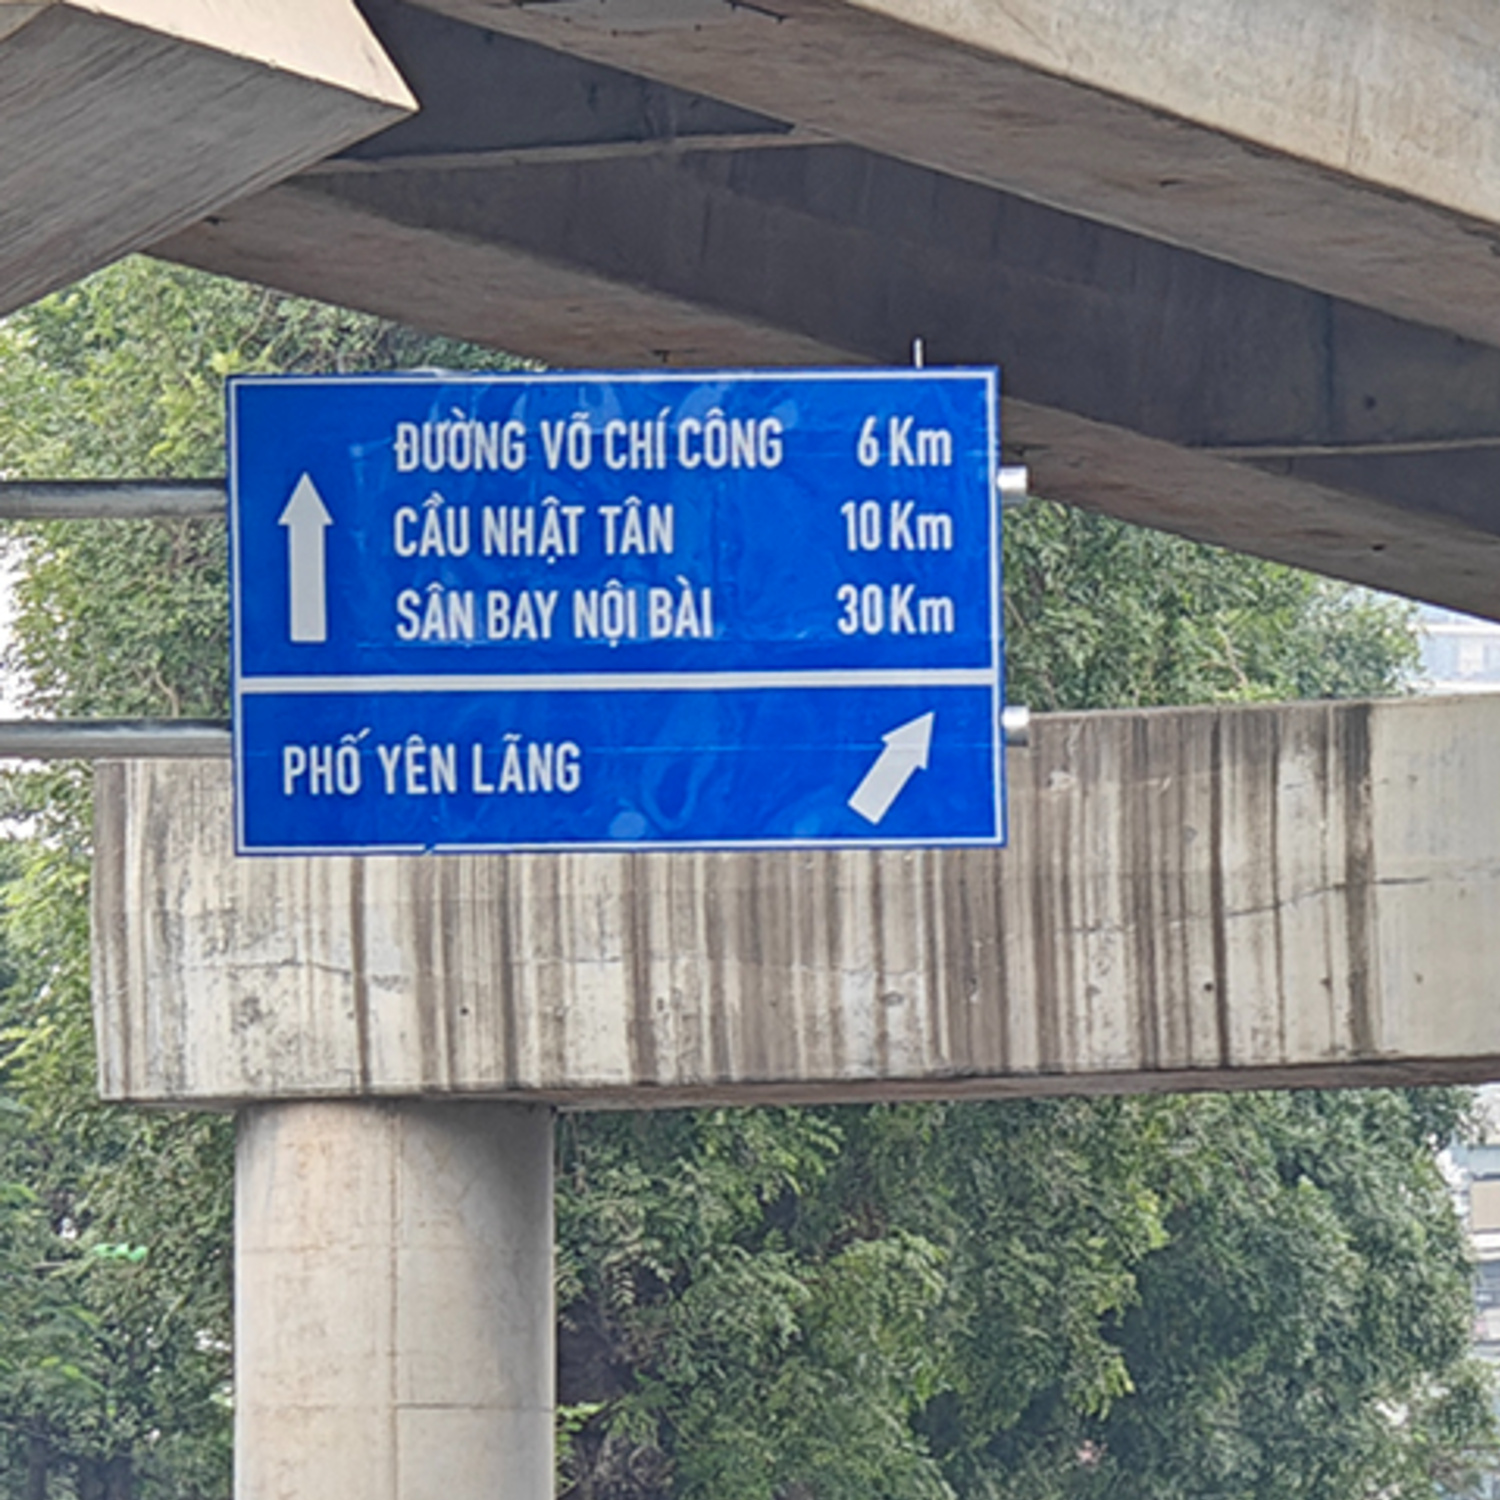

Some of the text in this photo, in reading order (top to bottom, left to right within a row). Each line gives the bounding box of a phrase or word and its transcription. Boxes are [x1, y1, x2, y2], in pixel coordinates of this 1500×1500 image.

[394, 406, 783, 472] ĐƯỜNG VÕ CHÍ CÔNG
[857, 416, 952, 467] 6 Km
[394, 491, 674, 565] CẦU NHẬT TÂN
[841, 500, 952, 551] 10 Km
[396, 575, 714, 648] SÂN BAY NỘI BÀI
[836, 584, 955, 635] 30 Km
[283, 727, 581, 796] PHỐ YÊN LÃNG
